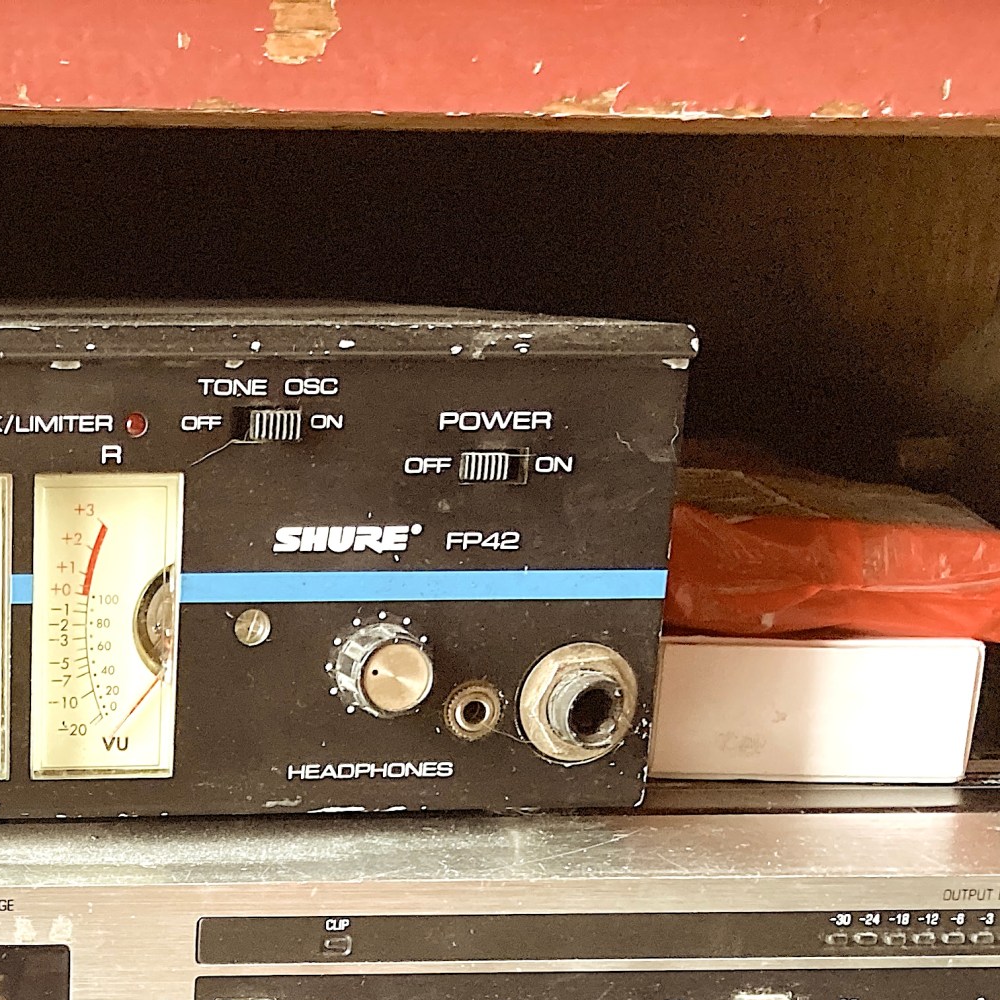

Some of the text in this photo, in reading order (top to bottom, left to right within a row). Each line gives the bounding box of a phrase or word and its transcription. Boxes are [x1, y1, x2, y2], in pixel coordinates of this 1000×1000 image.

[198, 378, 339, 395] TONE OSC
[181, 416, 222, 430] OFF
[310, 414, 343, 429] ON
[438, 411, 552, 430] POWER
[101, 445, 122, 464] R
[404, 457, 451, 474] OFF
[534, 456, 573, 473] ON
[273, 525, 521, 553] SHURE FP42
[102, 737, 129, 751] VU
[287, 762, 453, 780] HEADPHONES
[325, 919, 350, 931] CLIP
